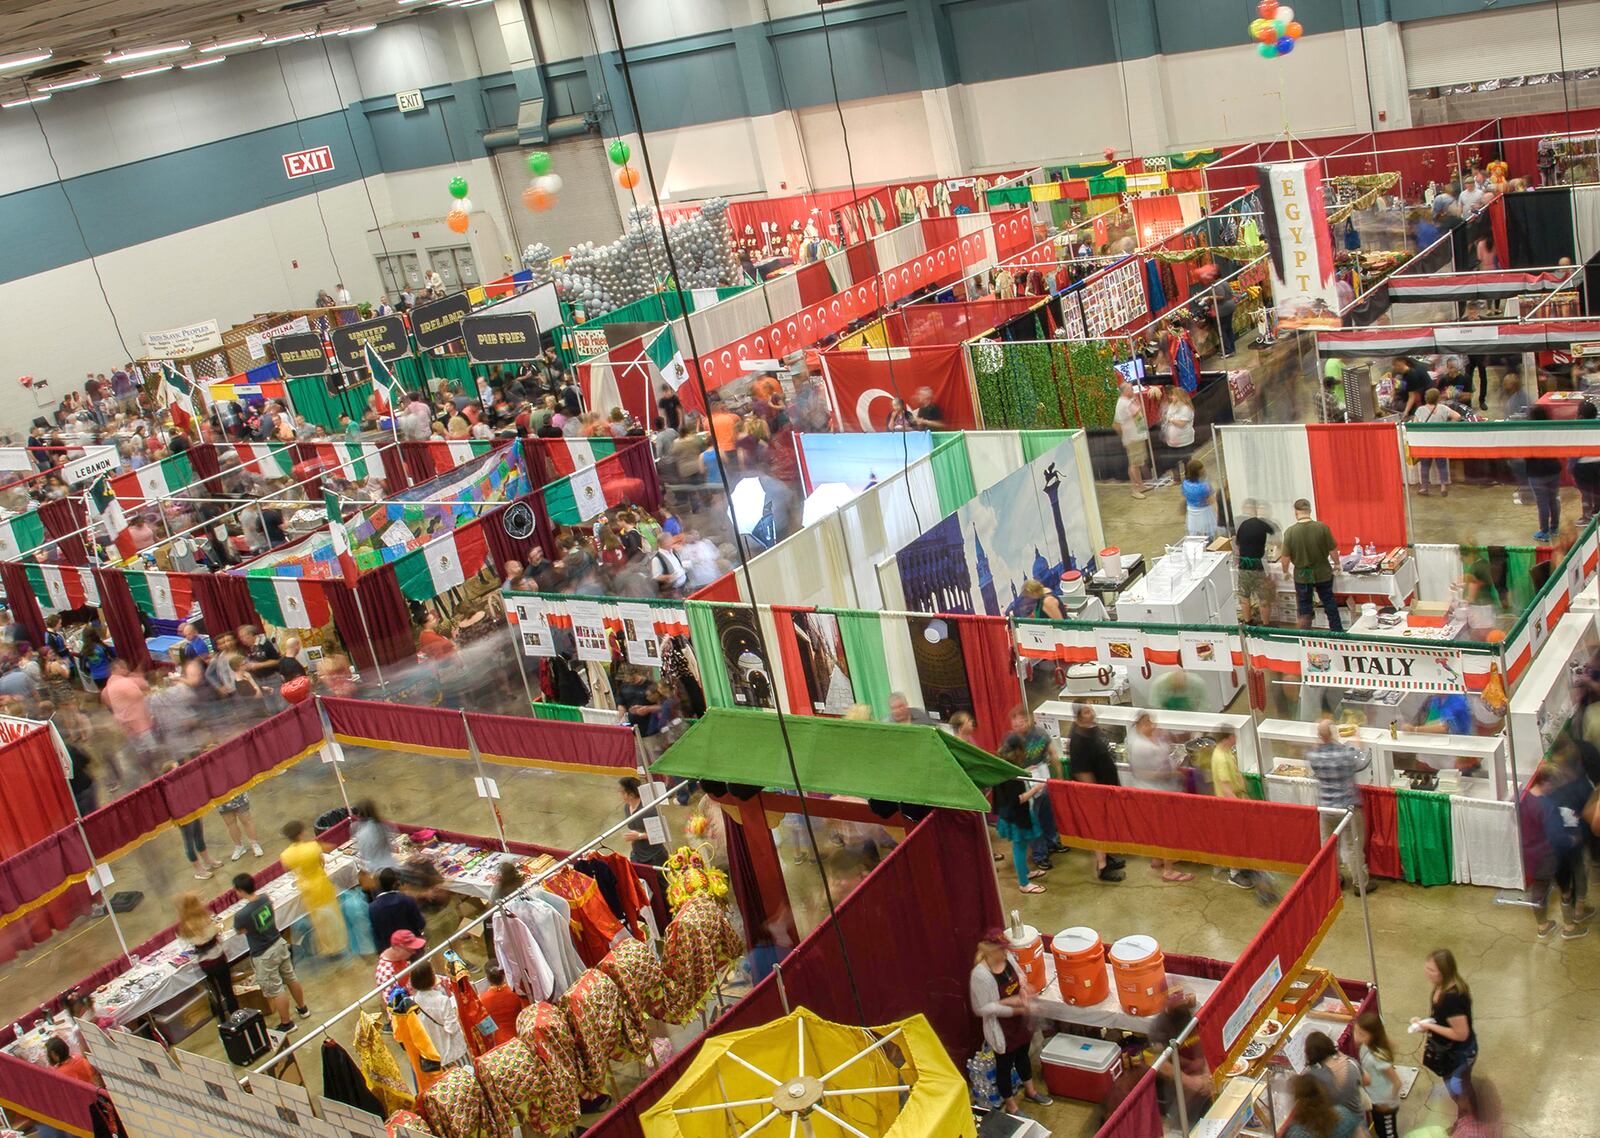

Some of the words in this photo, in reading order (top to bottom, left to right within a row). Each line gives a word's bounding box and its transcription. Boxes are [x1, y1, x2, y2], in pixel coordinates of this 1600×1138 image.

[400, 93, 419, 109] EXIT
[287, 149, 328, 175] EXIT
[1281, 179, 1311, 292] EGYPT
[419, 310, 466, 334] IRELAND
[348, 326, 388, 340] UNITED
[477, 332, 499, 346] PUB
[499, 331, 526, 345] FRIES
[280, 348, 322, 363] IRELAND
[350, 342, 396, 360] DATON
[75, 458, 112, 479] LEBANON
[1342, 655, 1416, 677] ITALY
